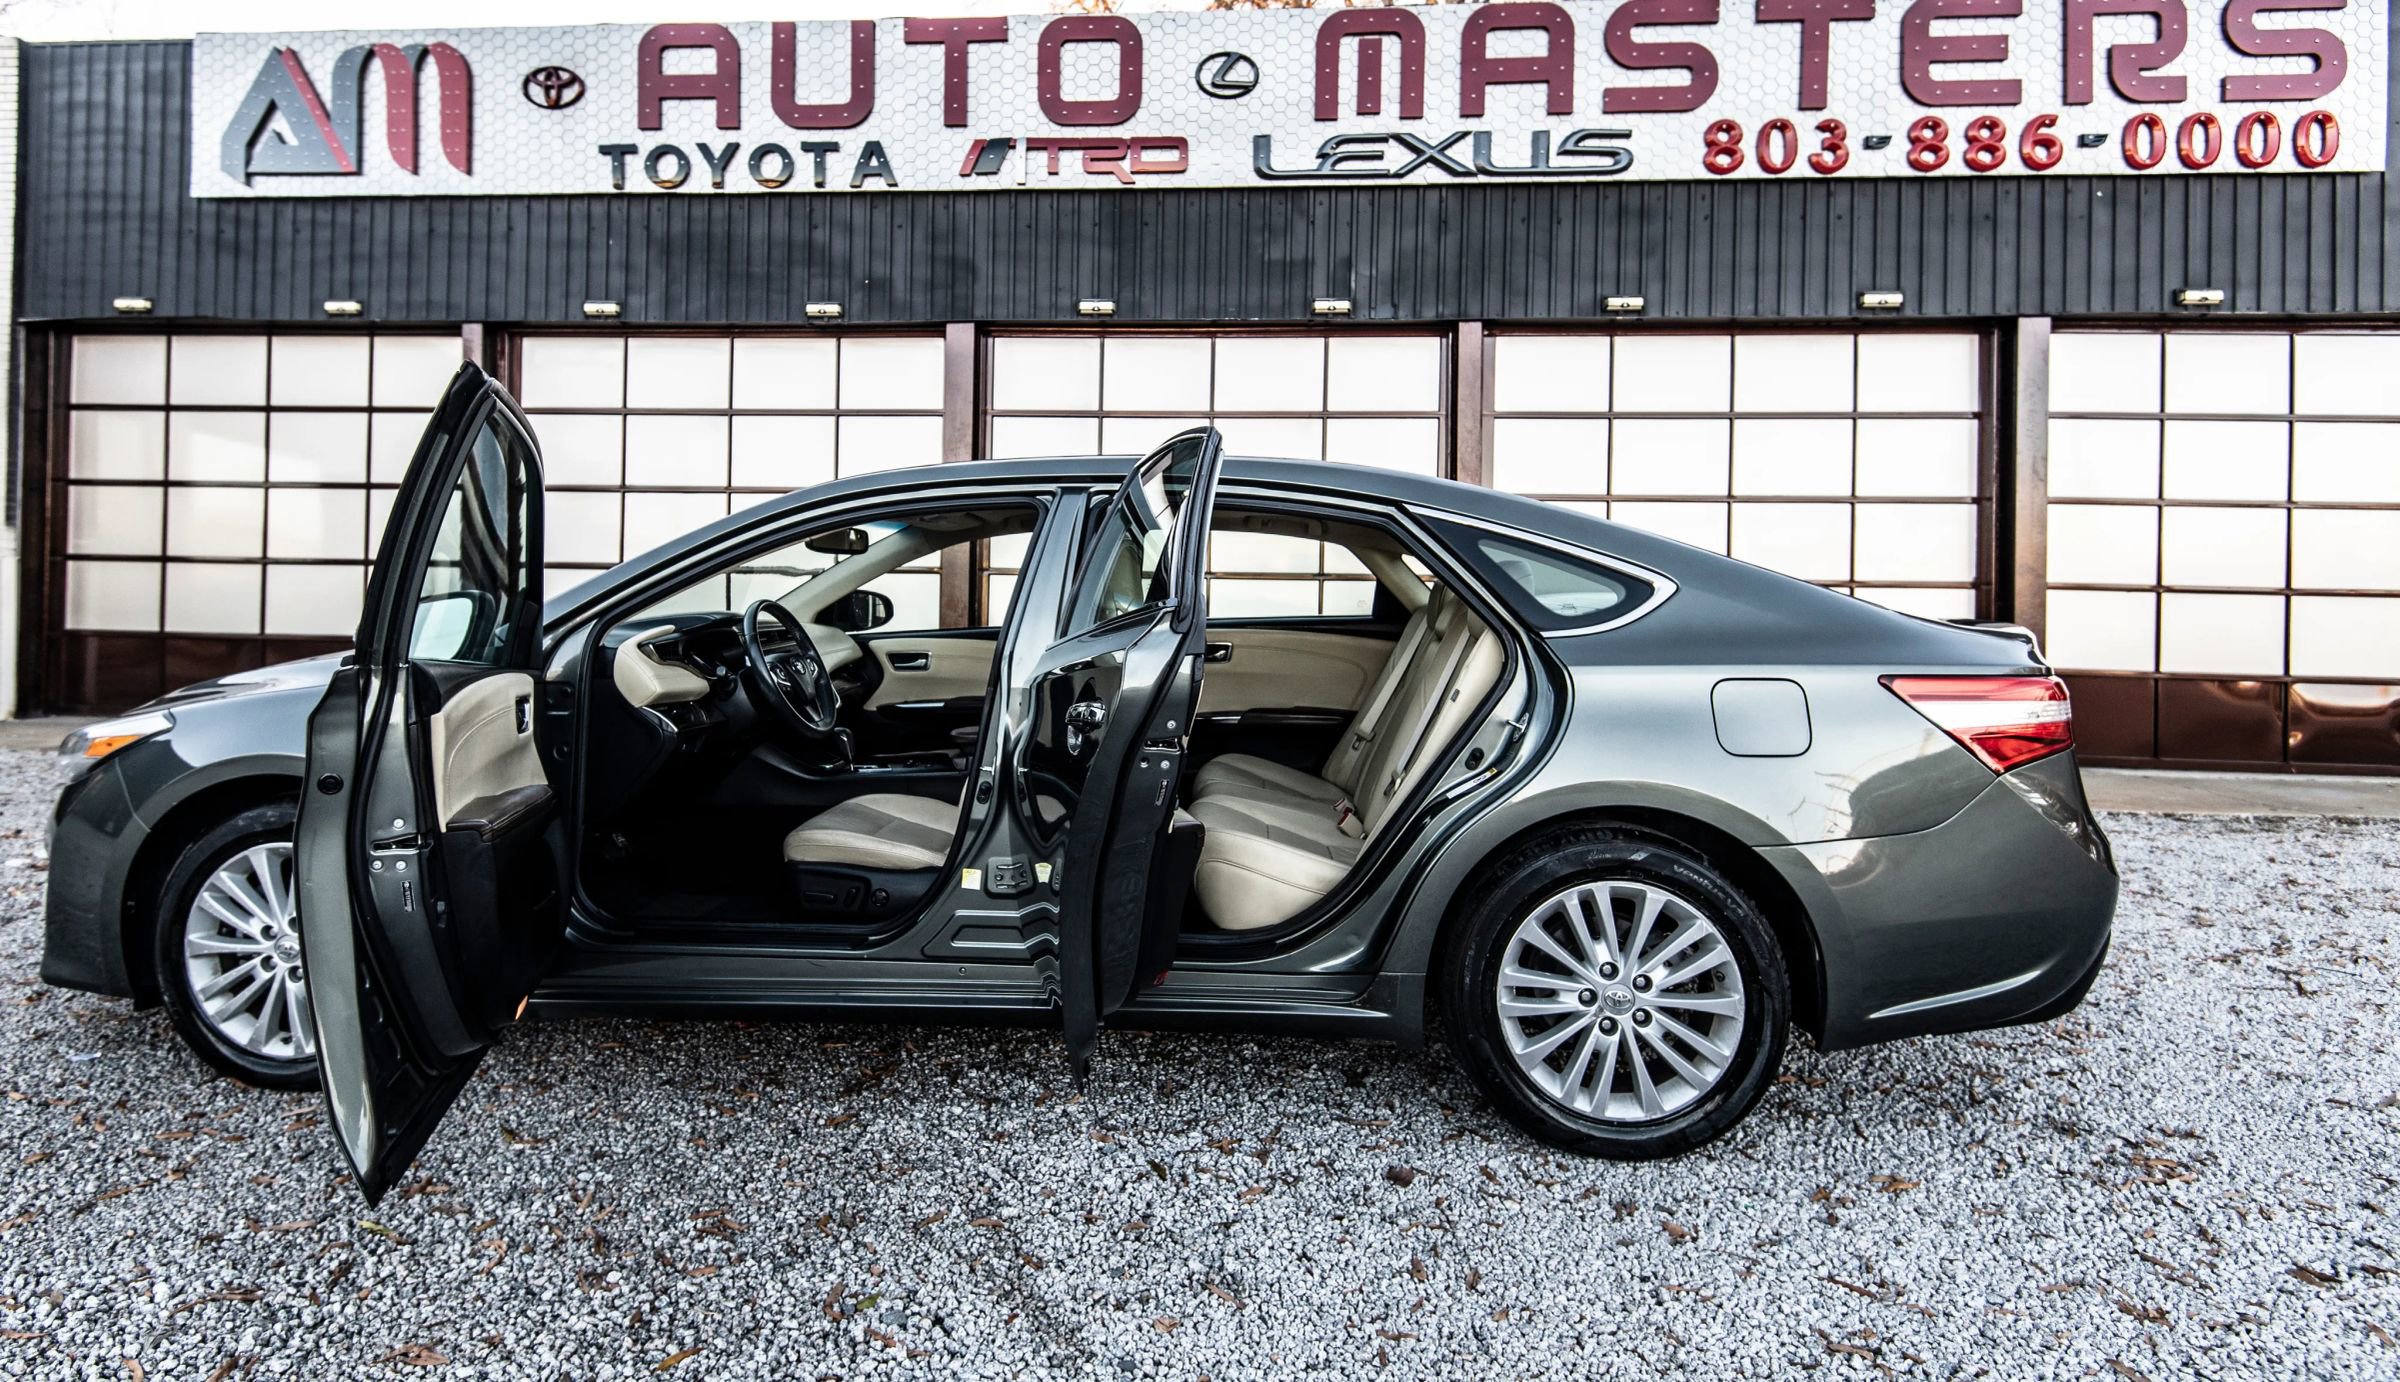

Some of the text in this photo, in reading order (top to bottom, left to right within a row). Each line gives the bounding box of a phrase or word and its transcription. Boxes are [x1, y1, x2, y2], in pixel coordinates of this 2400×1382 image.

[637, 0, 2348, 130] AUTO MASTERS
[600, 141, 898, 190] TOYOTA
[1010, 136, 1190, 185] TRD
[1253, 129, 1633, 180] LEXUS
[1703, 110, 2341, 173] 803-886-0000
